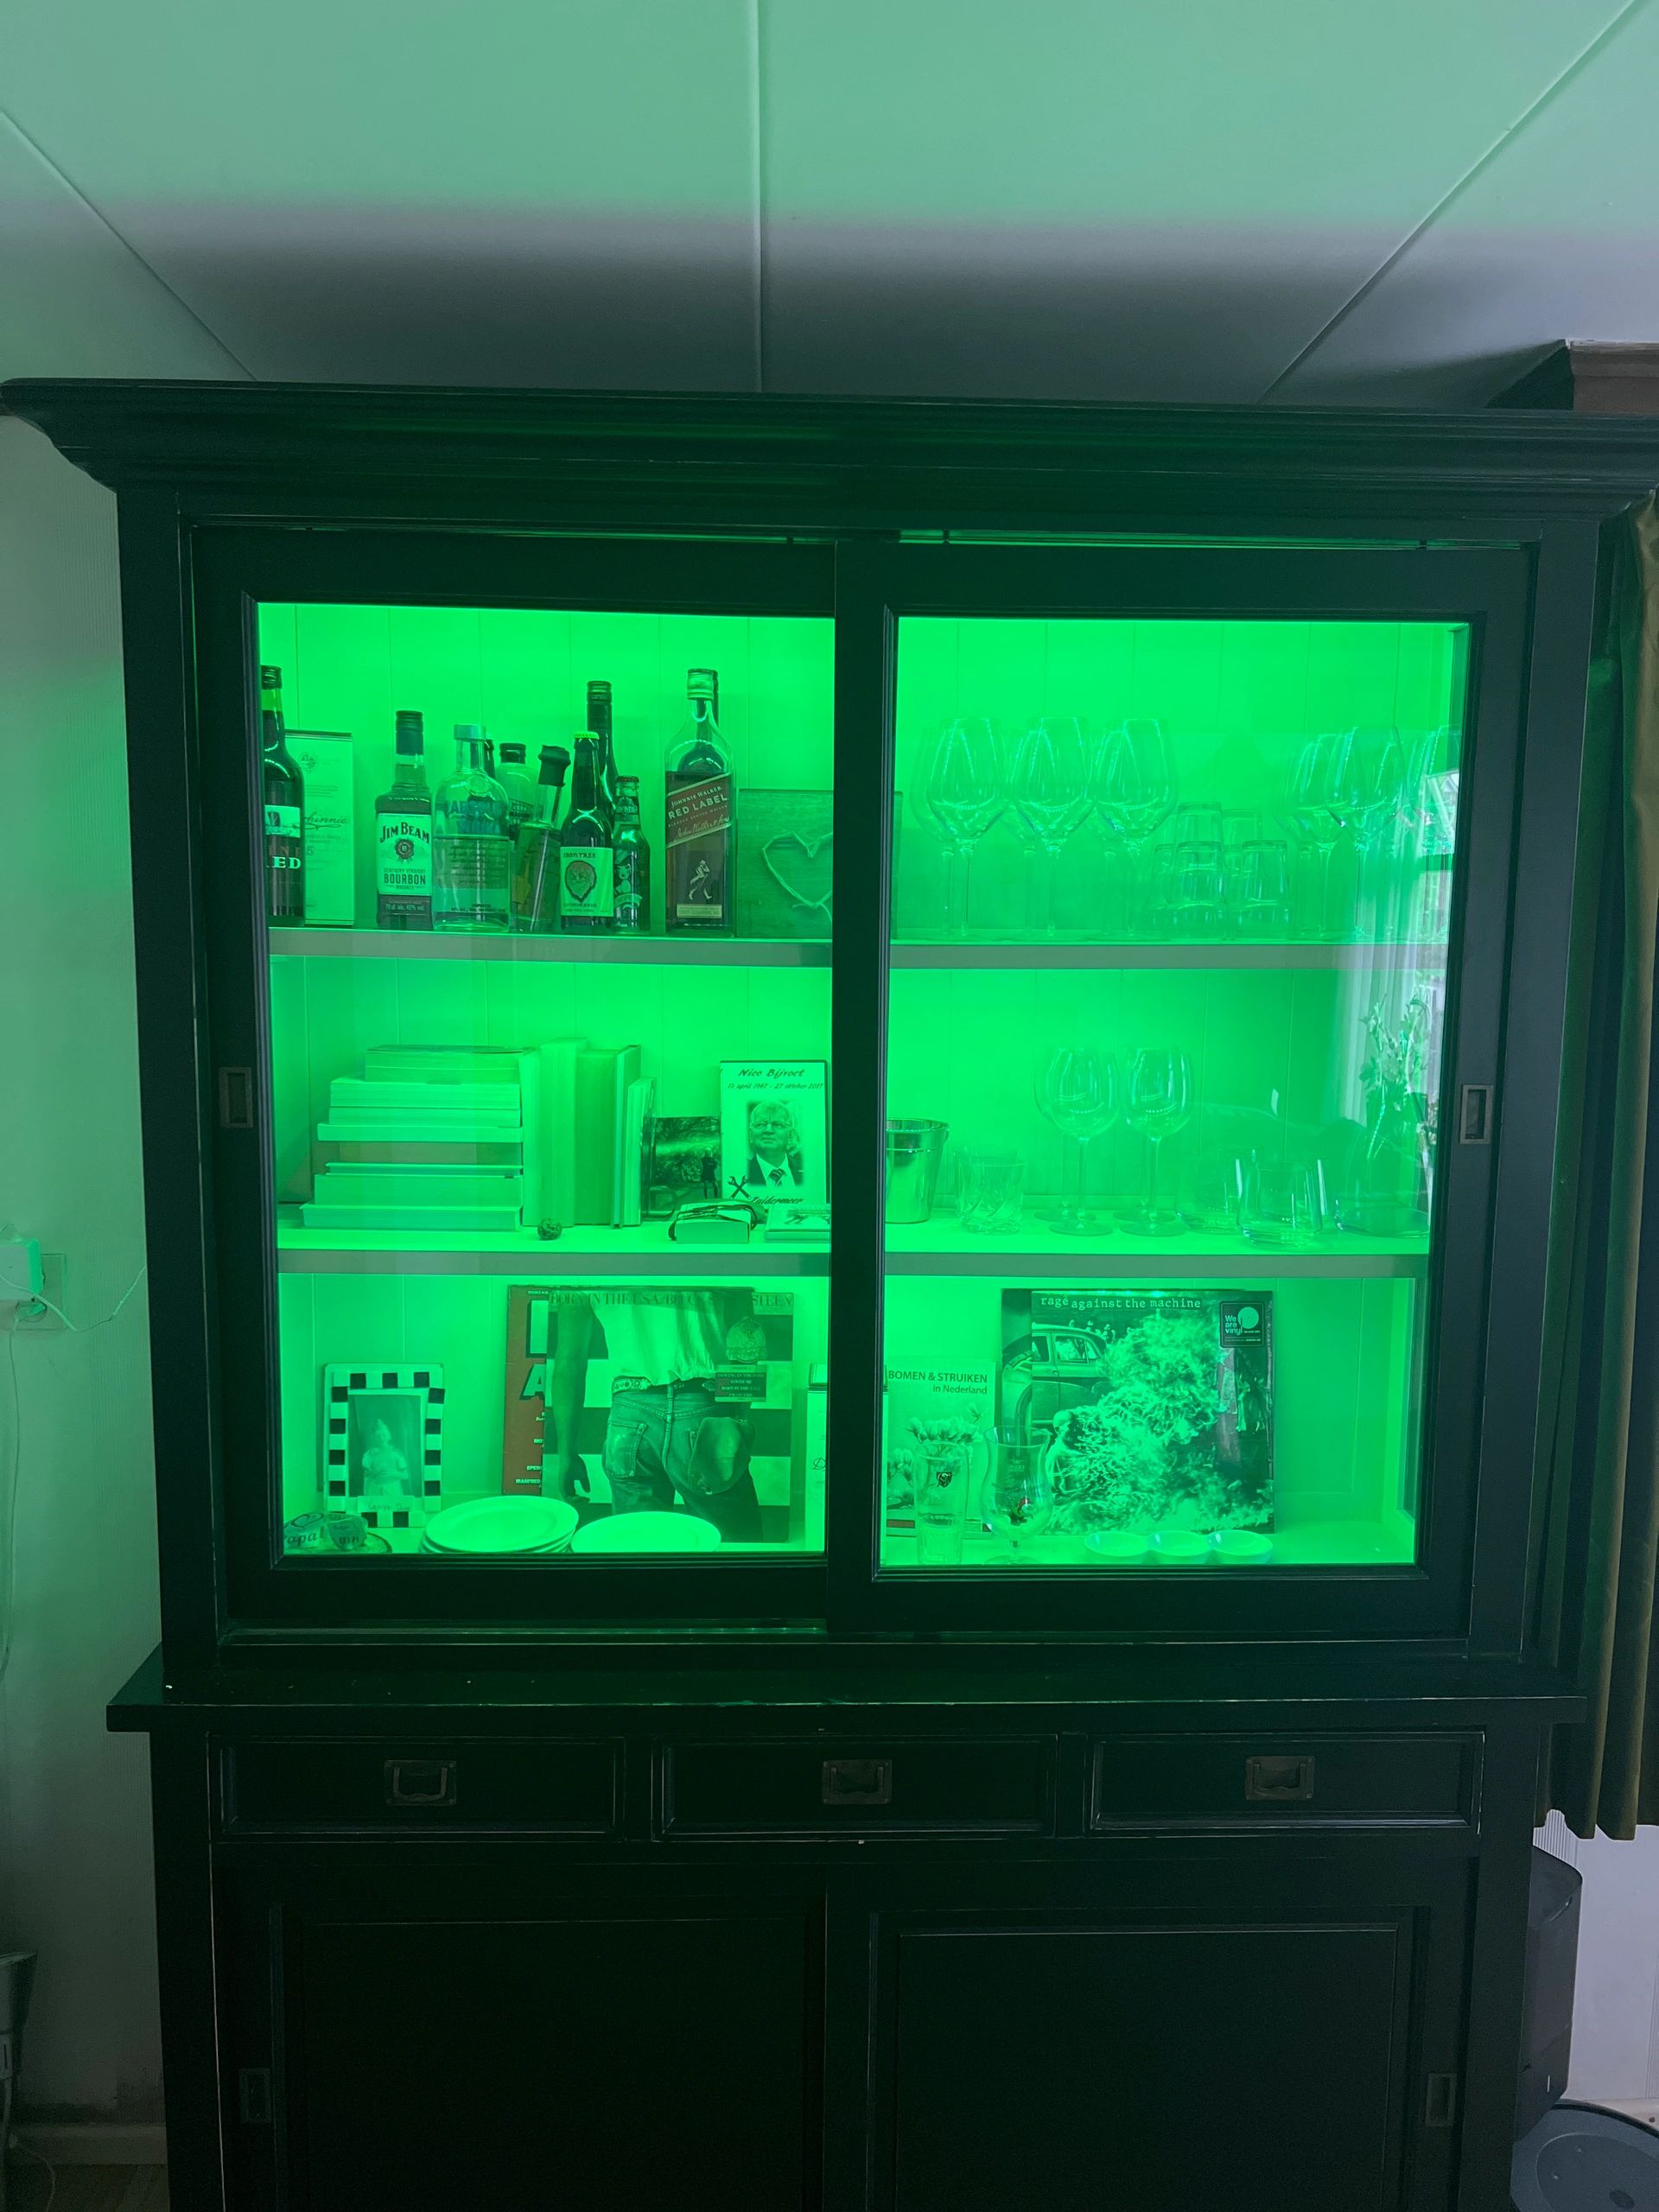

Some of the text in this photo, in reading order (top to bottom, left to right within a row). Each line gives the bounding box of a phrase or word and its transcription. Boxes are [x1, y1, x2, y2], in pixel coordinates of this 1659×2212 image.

[671, 785, 723, 808] JOHNNIE WALKER
[668, 793, 728, 820] RED LABEL
[380, 821, 429, 844] JIM BEAM
[384, 874, 426, 886] BOURBON
[738, 1068, 763, 1077] Nico
[550, 1293, 584, 1305] BORN
[588, 1293, 602, 1305] IN
[604, 1294, 630, 1306] THE
[1040, 1295, 1202, 1311] rage against the machine
[1224, 1326, 1243, 1336] vinyl
[888, 1370, 988, 1383] BOMEN & STRUIKEN
[932, 1384, 988, 1395] in Nederland
